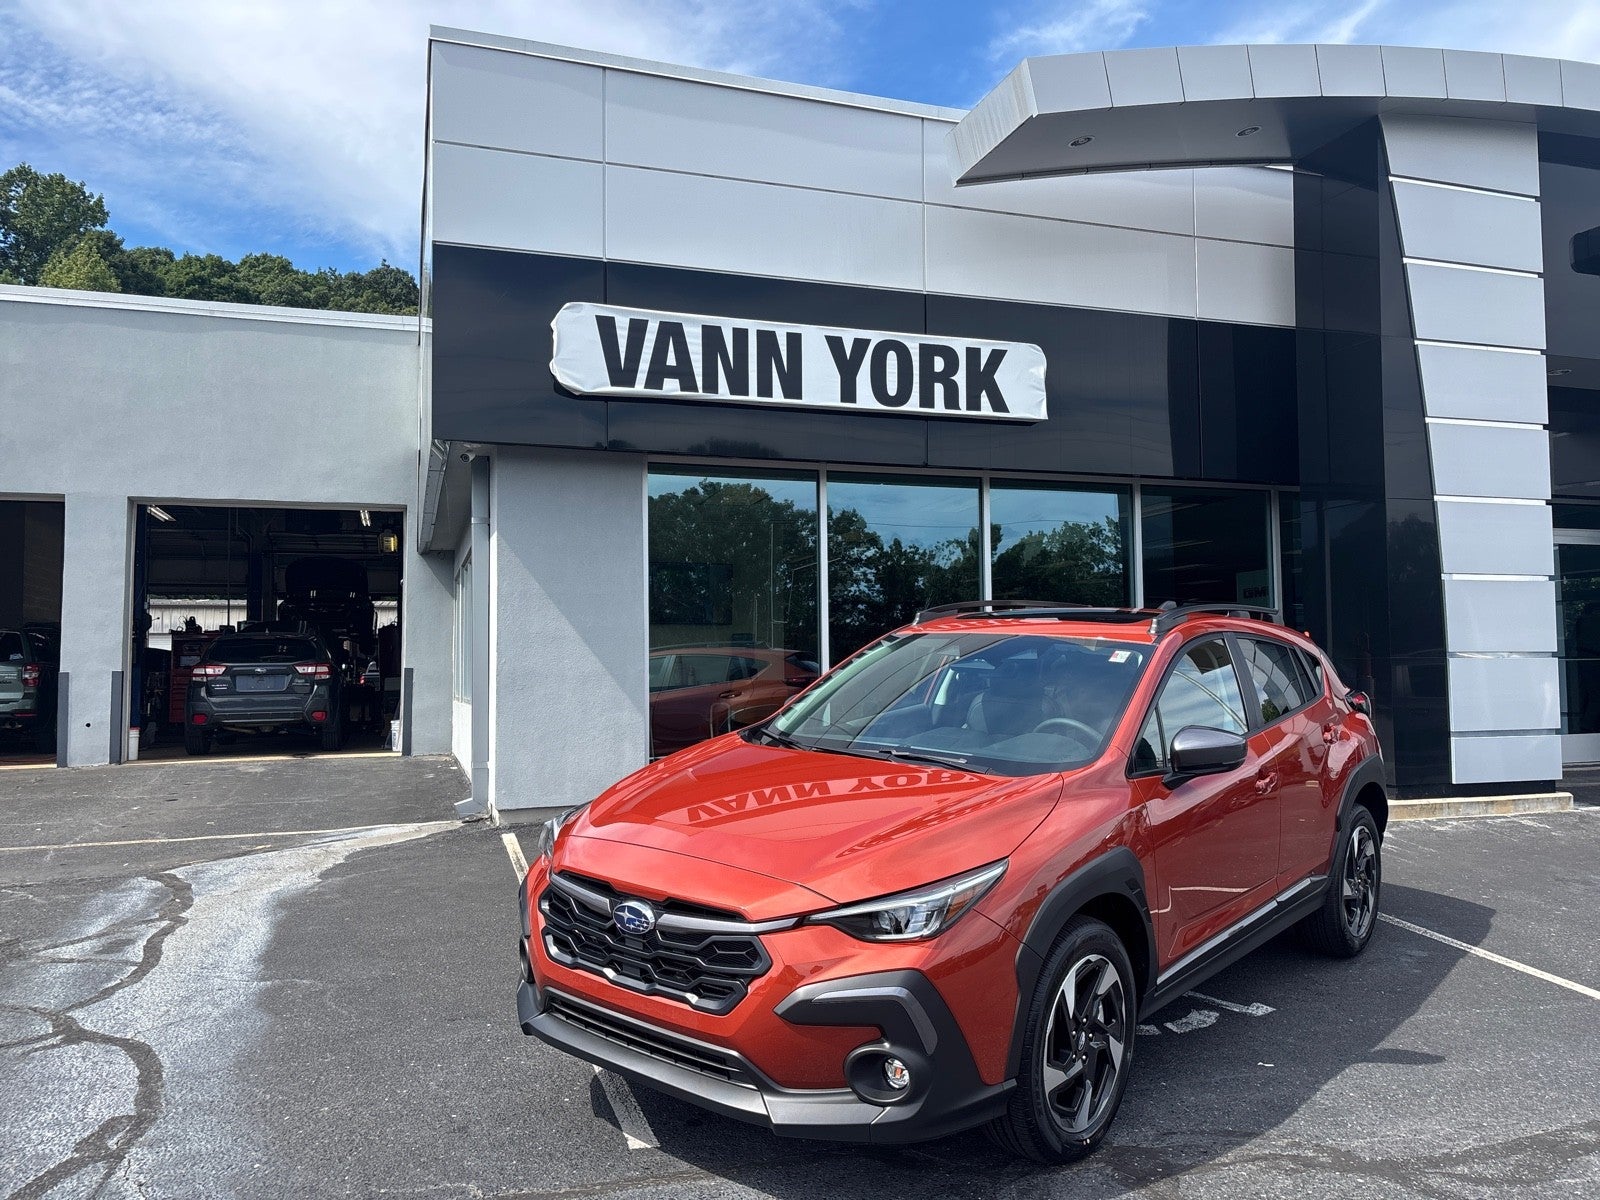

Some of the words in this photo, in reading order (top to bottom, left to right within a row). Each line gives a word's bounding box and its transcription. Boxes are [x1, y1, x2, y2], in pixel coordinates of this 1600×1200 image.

[595, 314, 802, 400] VANN
[824, 335, 1010, 413] YORK
[1243, 586, 1269, 599] GM
